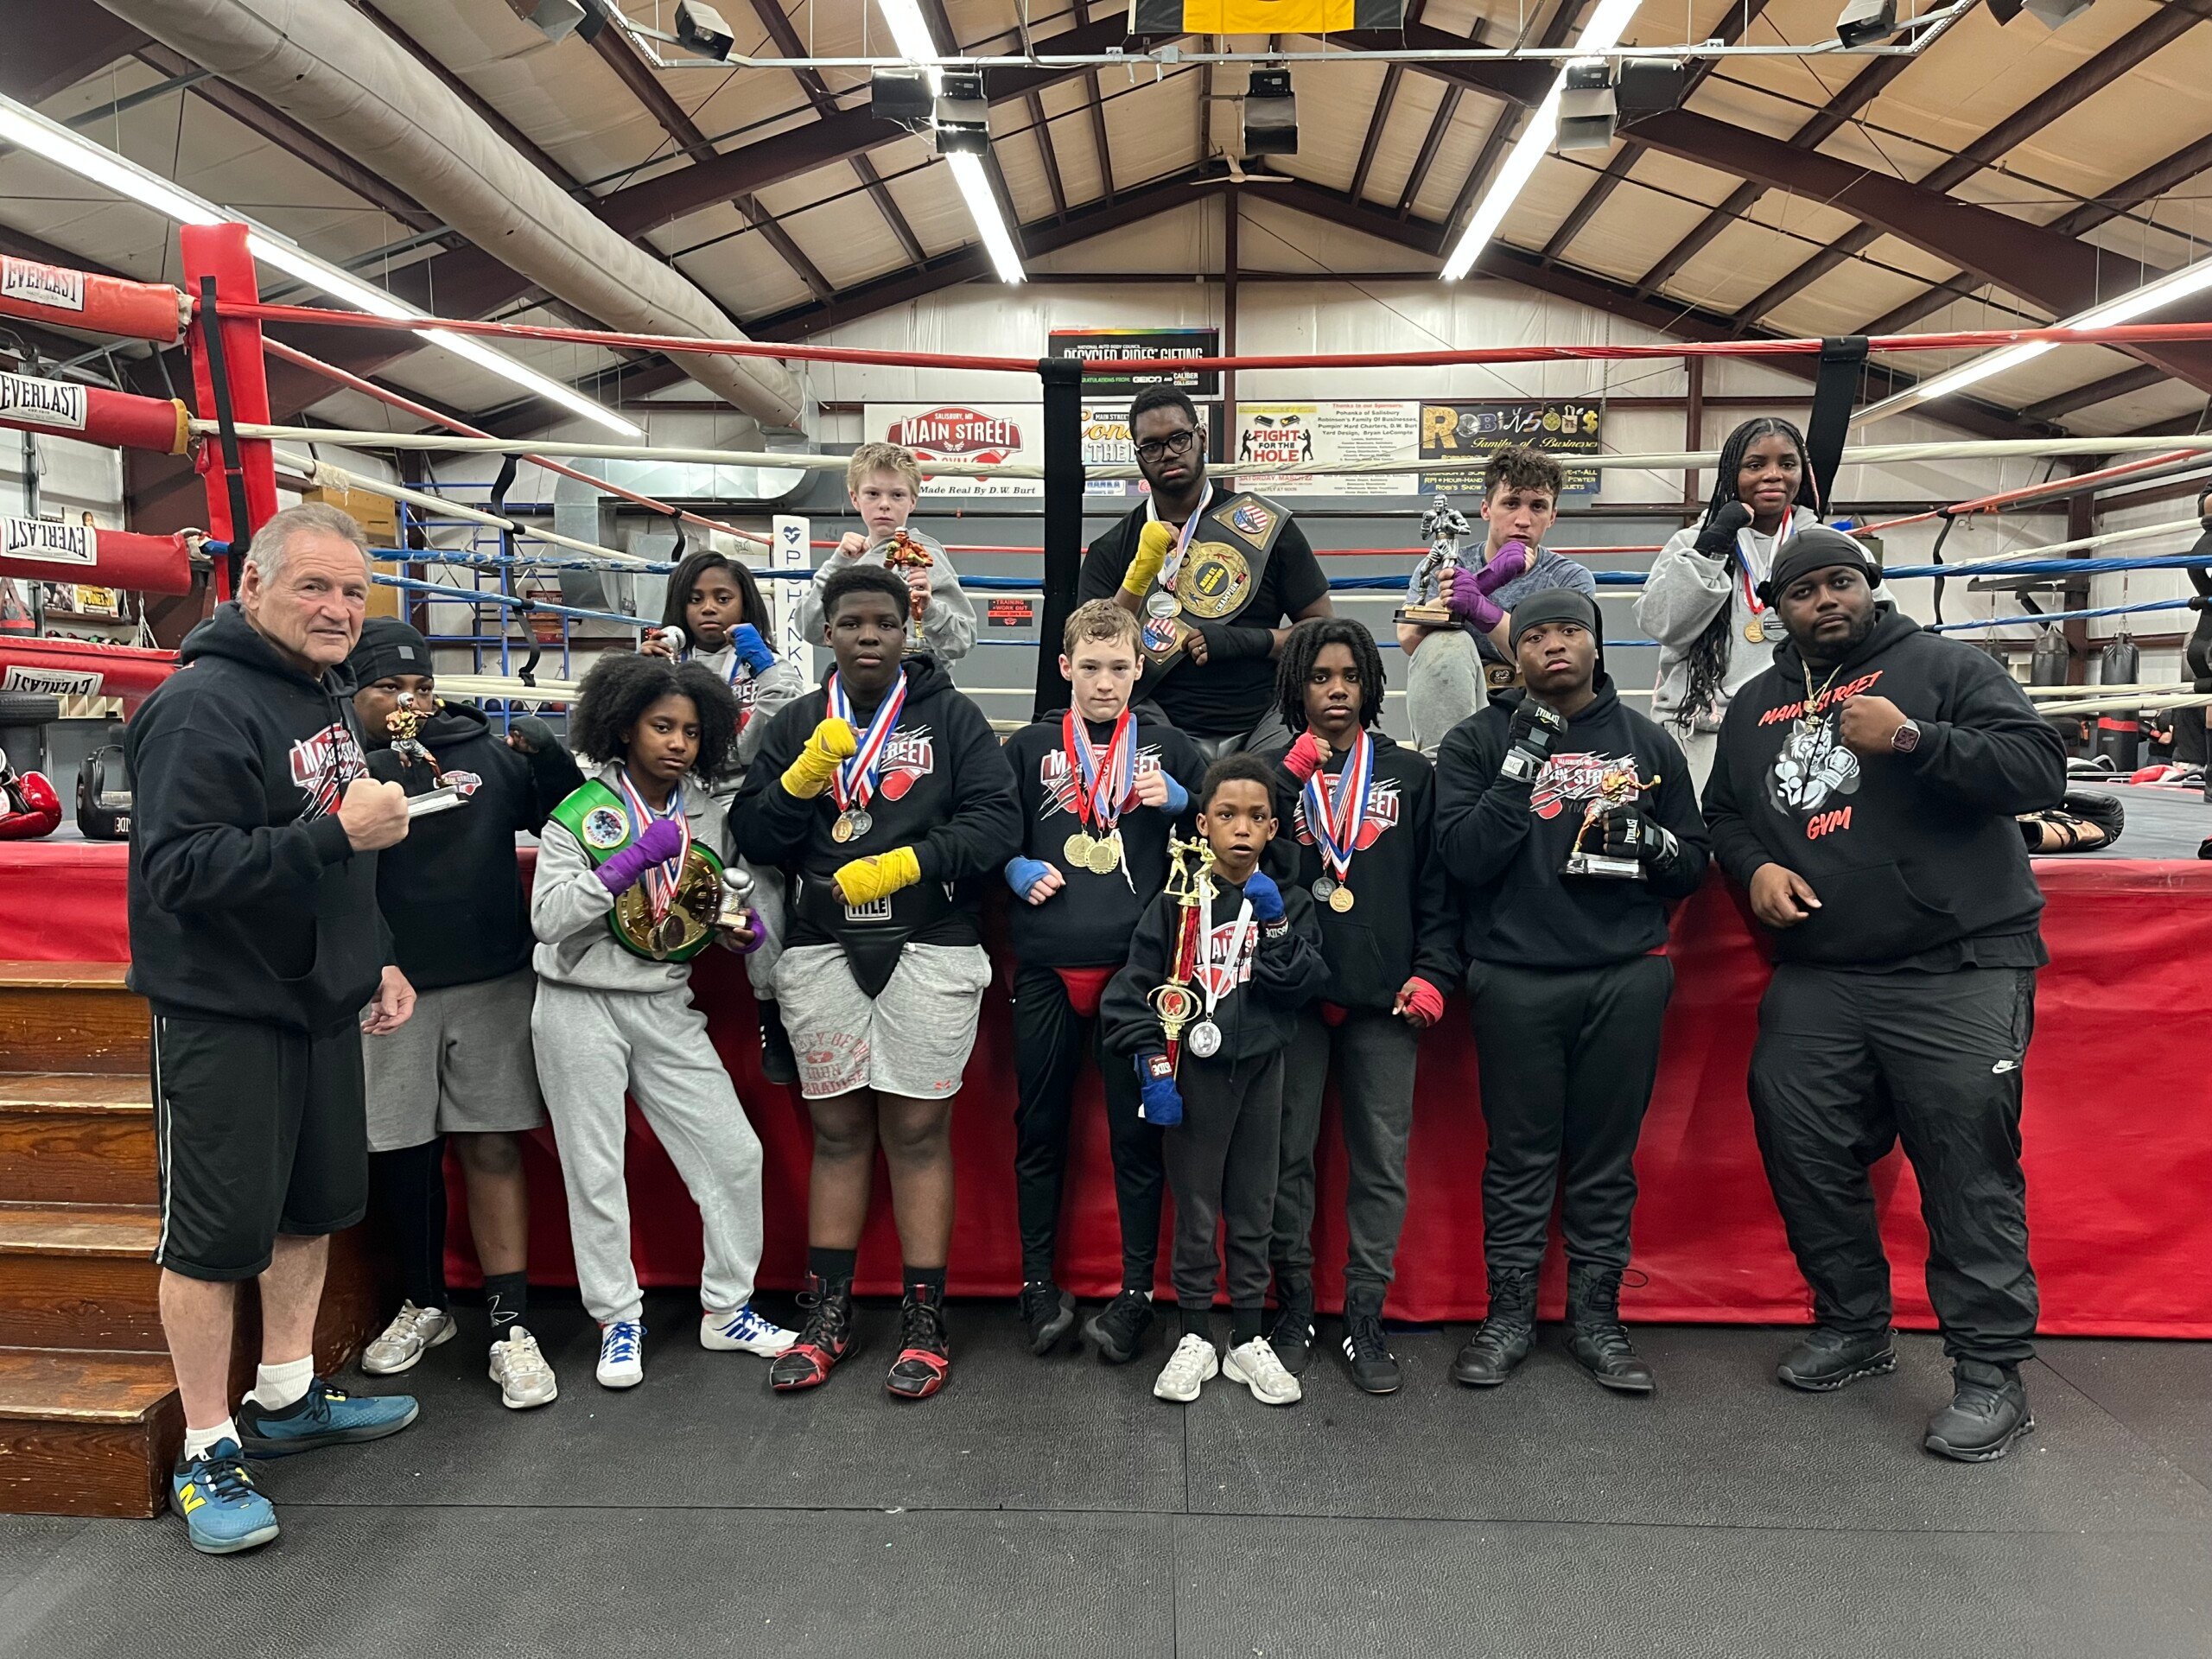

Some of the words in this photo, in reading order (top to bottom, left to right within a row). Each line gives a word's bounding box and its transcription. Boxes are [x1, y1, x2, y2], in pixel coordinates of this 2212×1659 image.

[1132, 375, 1162, 384] GEICO
[0, 374, 78, 421] EVERLAST
[901, 416, 950, 446] MAIN
[955, 417, 1013, 446] STREET
[1254, 430, 1300, 442] FIGHT
[1471, 436, 1512, 448] Family
[1520, 436, 1536, 448] of
[1539, 437, 1598, 448] Businesses
[1088, 443, 1126, 462] THE
[1253, 449, 1300, 462] HOLE
[974, 486, 988, 495] By
[10, 518, 87, 558] EVERLAST
[1204, 568, 1224, 594] CHAMPION
[1215, 582, 1239, 612] CHAMPION
[11, 672, 93, 695] EVERLAST
[731, 683, 759, 702] REE
[1535, 706, 1560, 727] EVERLAST
[1758, 702, 1802, 727] MAIN
[884, 737, 931, 766] REET
[1807, 806, 1852, 839] GYM
[801, 1068, 865, 1095] ARADISE
